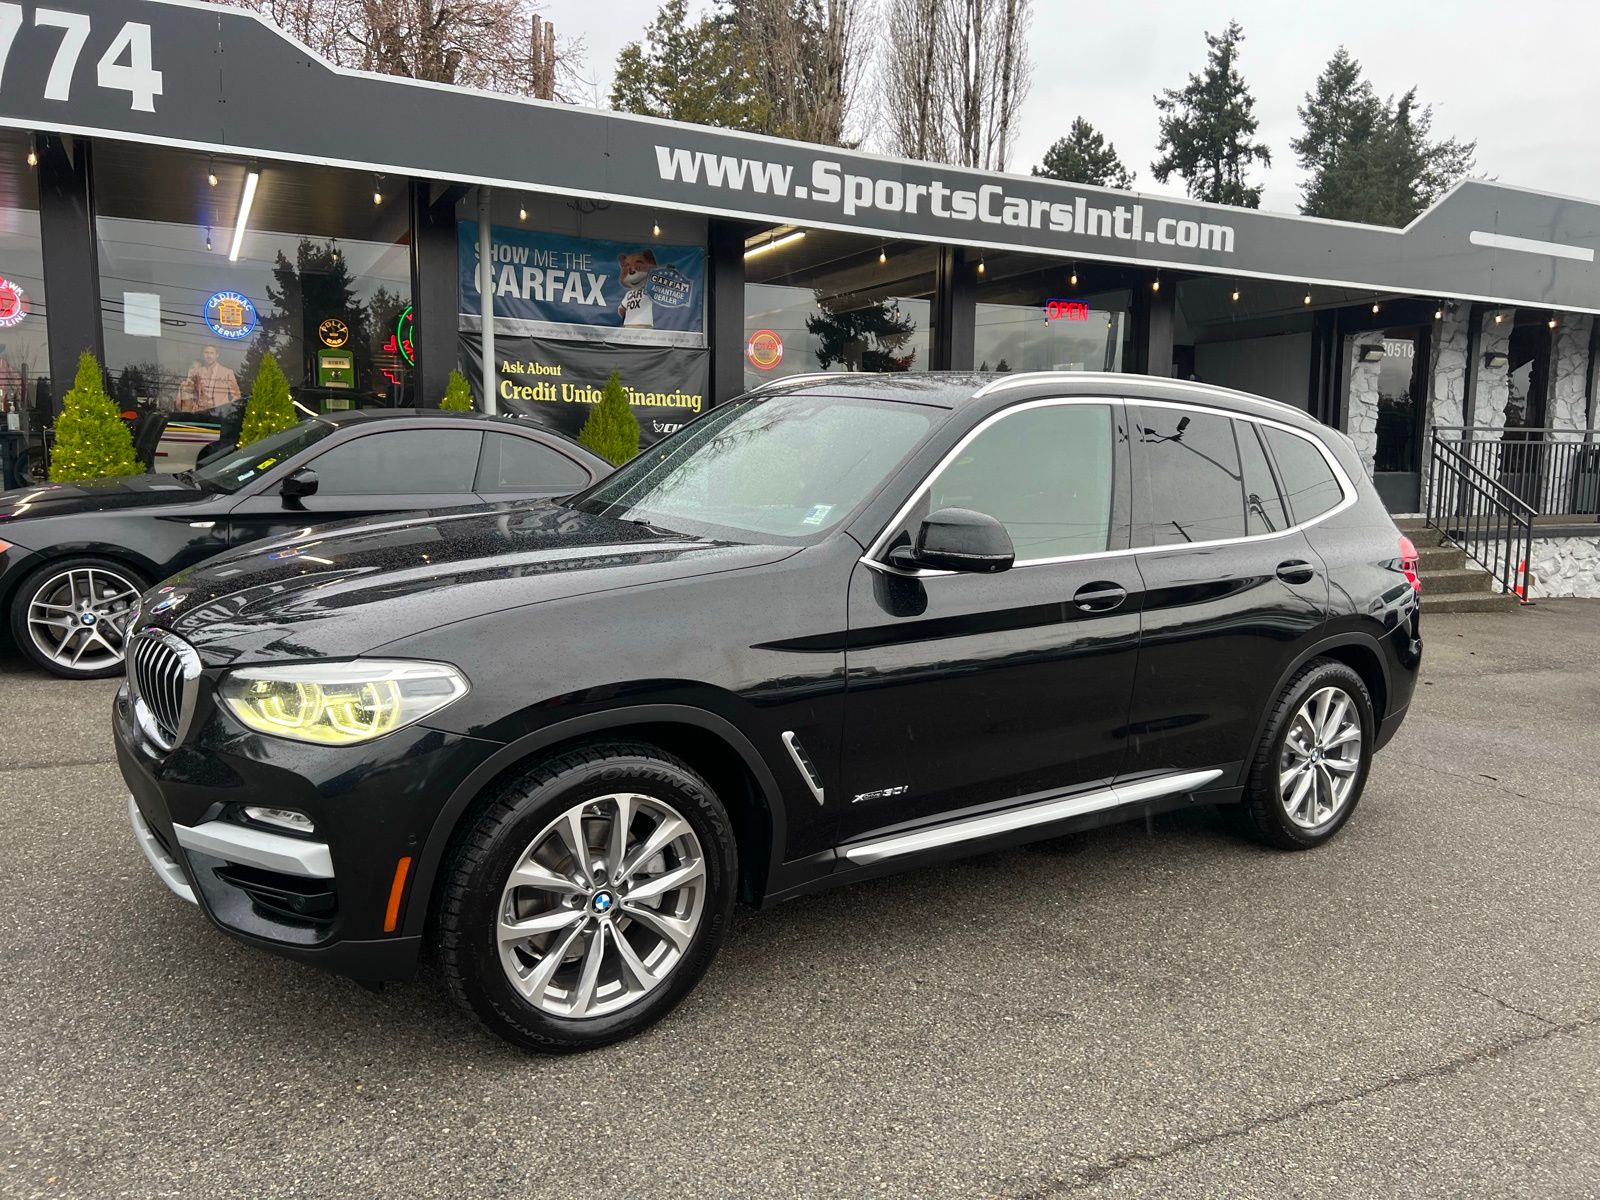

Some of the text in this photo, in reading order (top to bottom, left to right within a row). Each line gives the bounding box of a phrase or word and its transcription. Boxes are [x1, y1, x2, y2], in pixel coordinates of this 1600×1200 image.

[654, 145, 1235, 253] www.SportsCarsIntl.com
[534, 249, 558, 269] ME
[562, 252, 592, 272] THE
[474, 262, 608, 307] CARFAX
[651, 275, 690, 293] CARFAX
[651, 284, 685, 300] ADVANTAGE
[209, 292, 253, 311] CADILLAC
[626, 289, 643, 300] CAR
[653, 293, 678, 305] DEALER
[626, 299, 641, 311] FOX
[1047, 301, 1088, 321] OPEN
[212, 324, 249, 338] SERVICE
[1382, 342, 1415, 358] 20510
[501, 360, 562, 376] Ask About
[500, 380, 557, 402] Credit
[561, 384, 605, 404] Unio
[582, 766, 729, 849] CONTINENTAL
